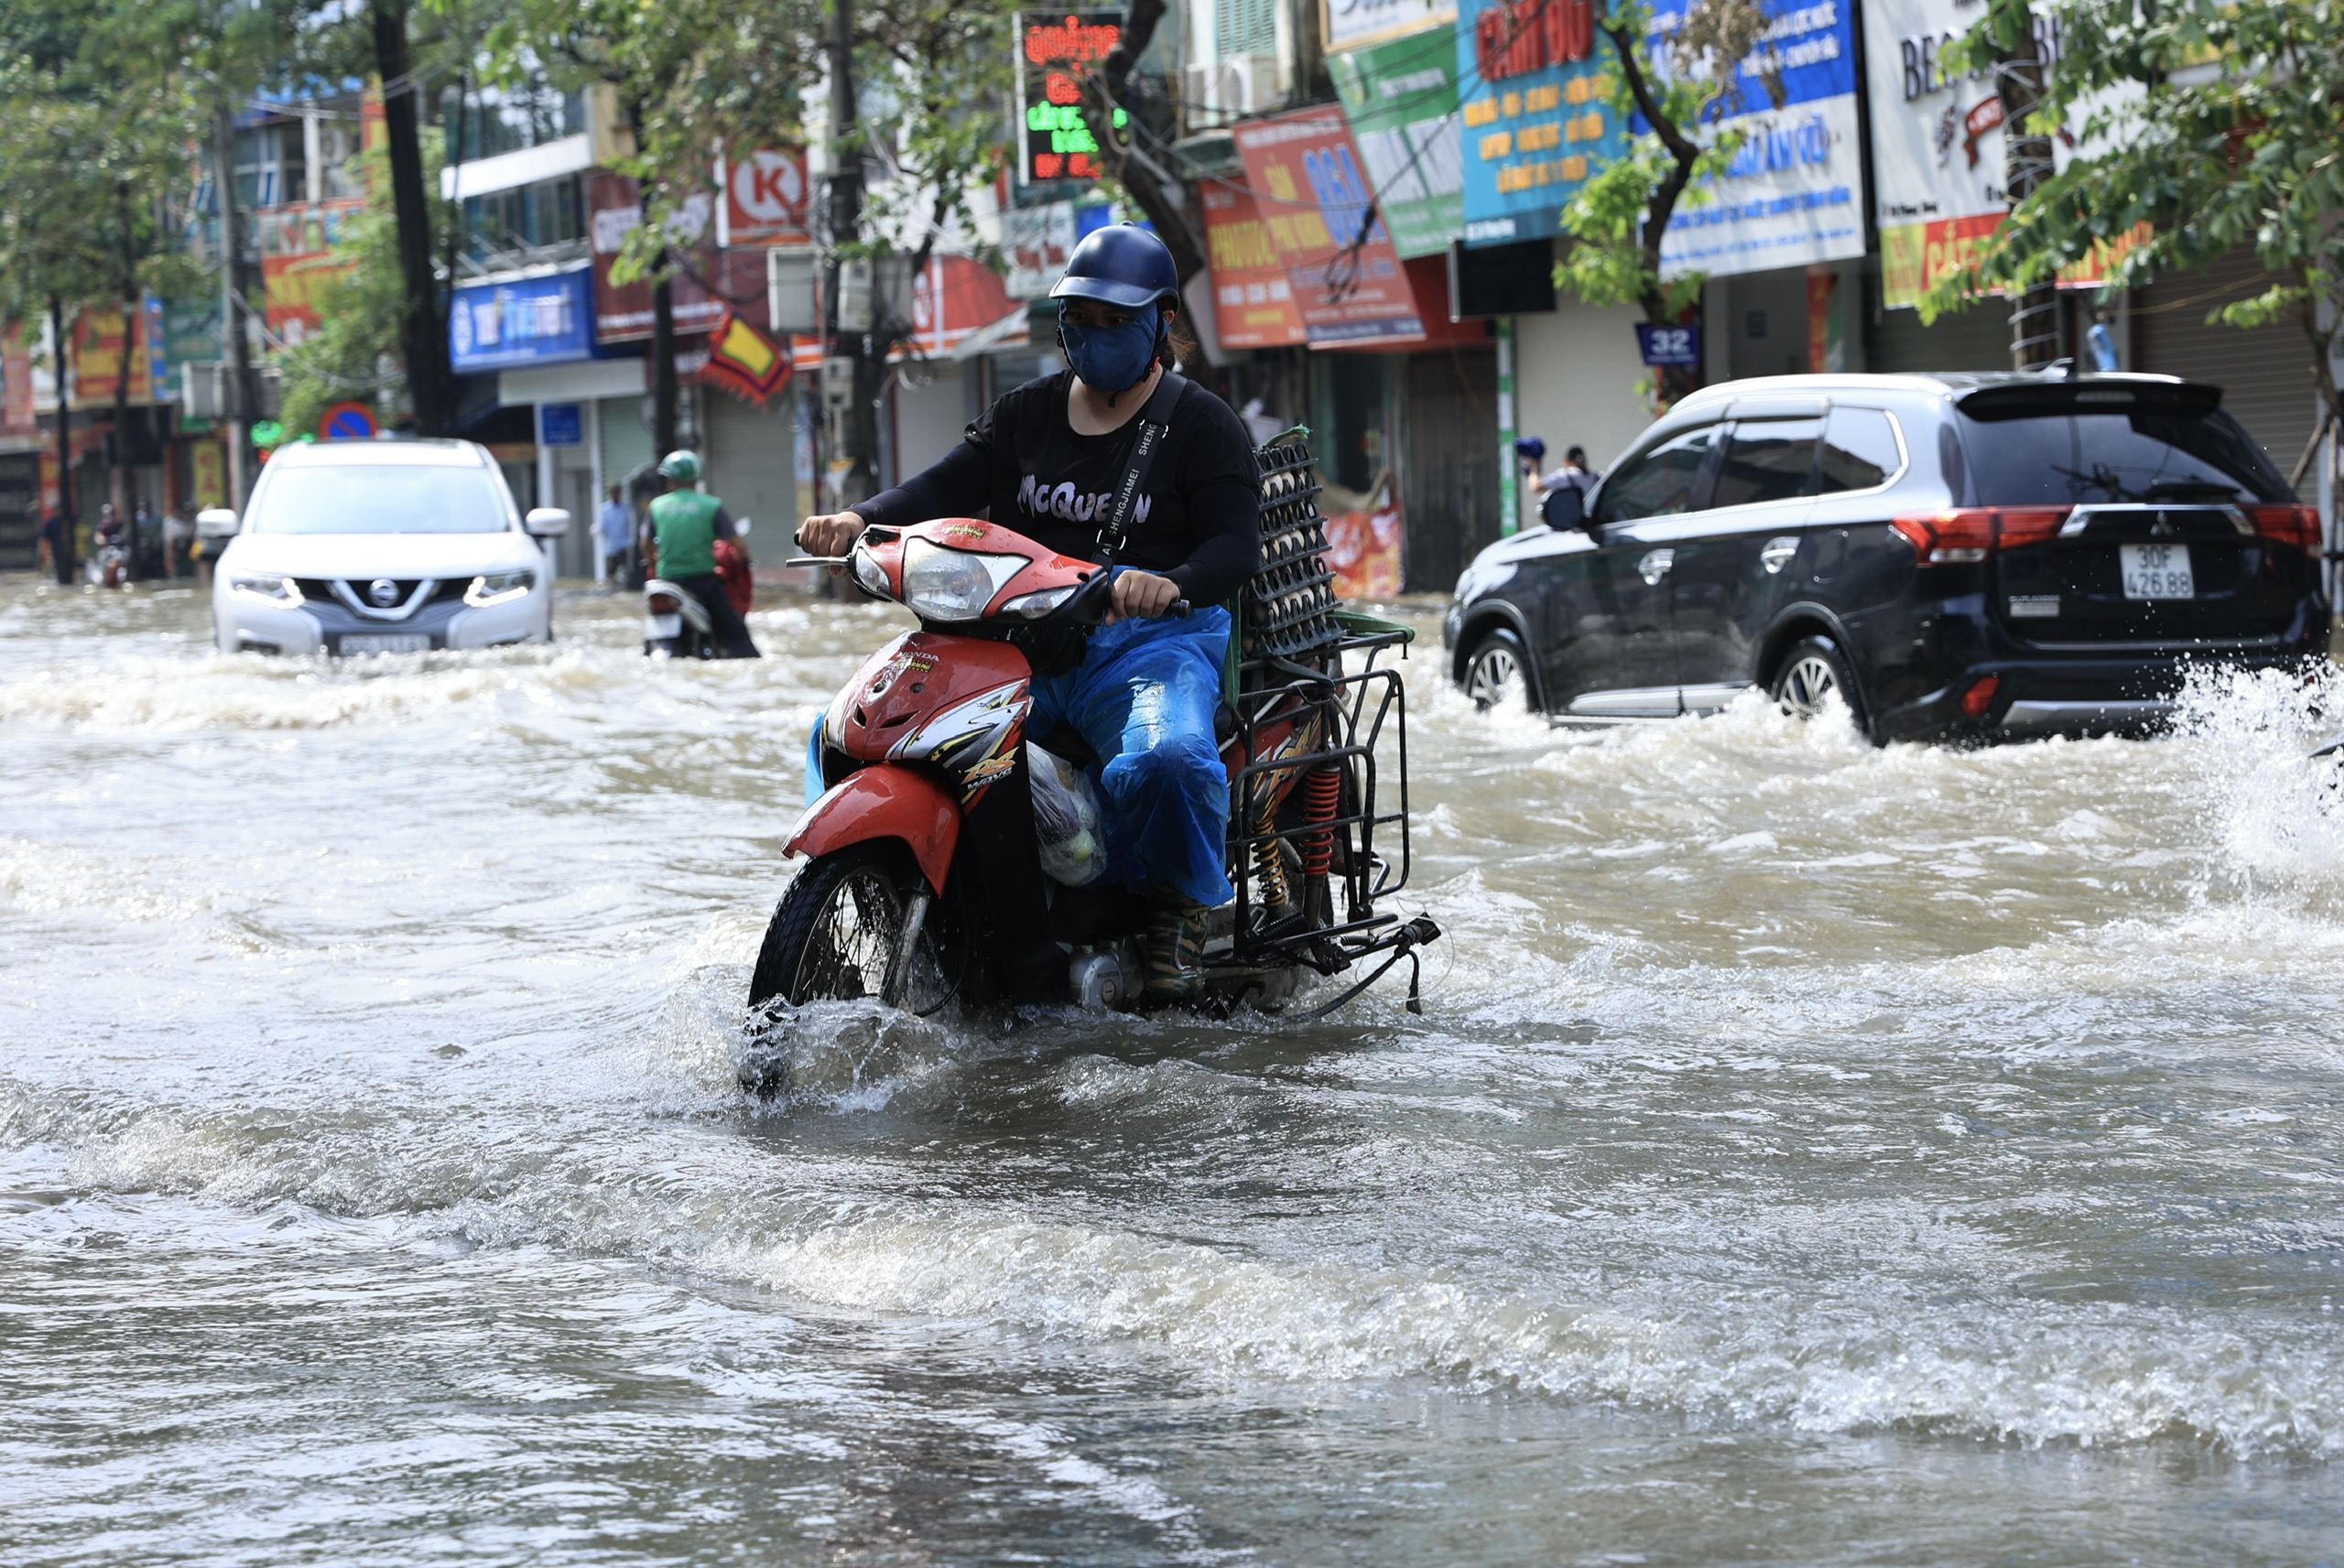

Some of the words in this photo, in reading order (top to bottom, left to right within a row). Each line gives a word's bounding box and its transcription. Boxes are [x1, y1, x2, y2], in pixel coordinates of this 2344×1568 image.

[754, 167, 797, 220] K
[1650, 329, 1691, 355] 32
[1109, 469, 1140, 537] SHENGJIAMEI
[2136, 545, 2173, 569] 30F
[960, 746, 1019, 784] RS
[1097, 970, 1120, 979] HONDA
